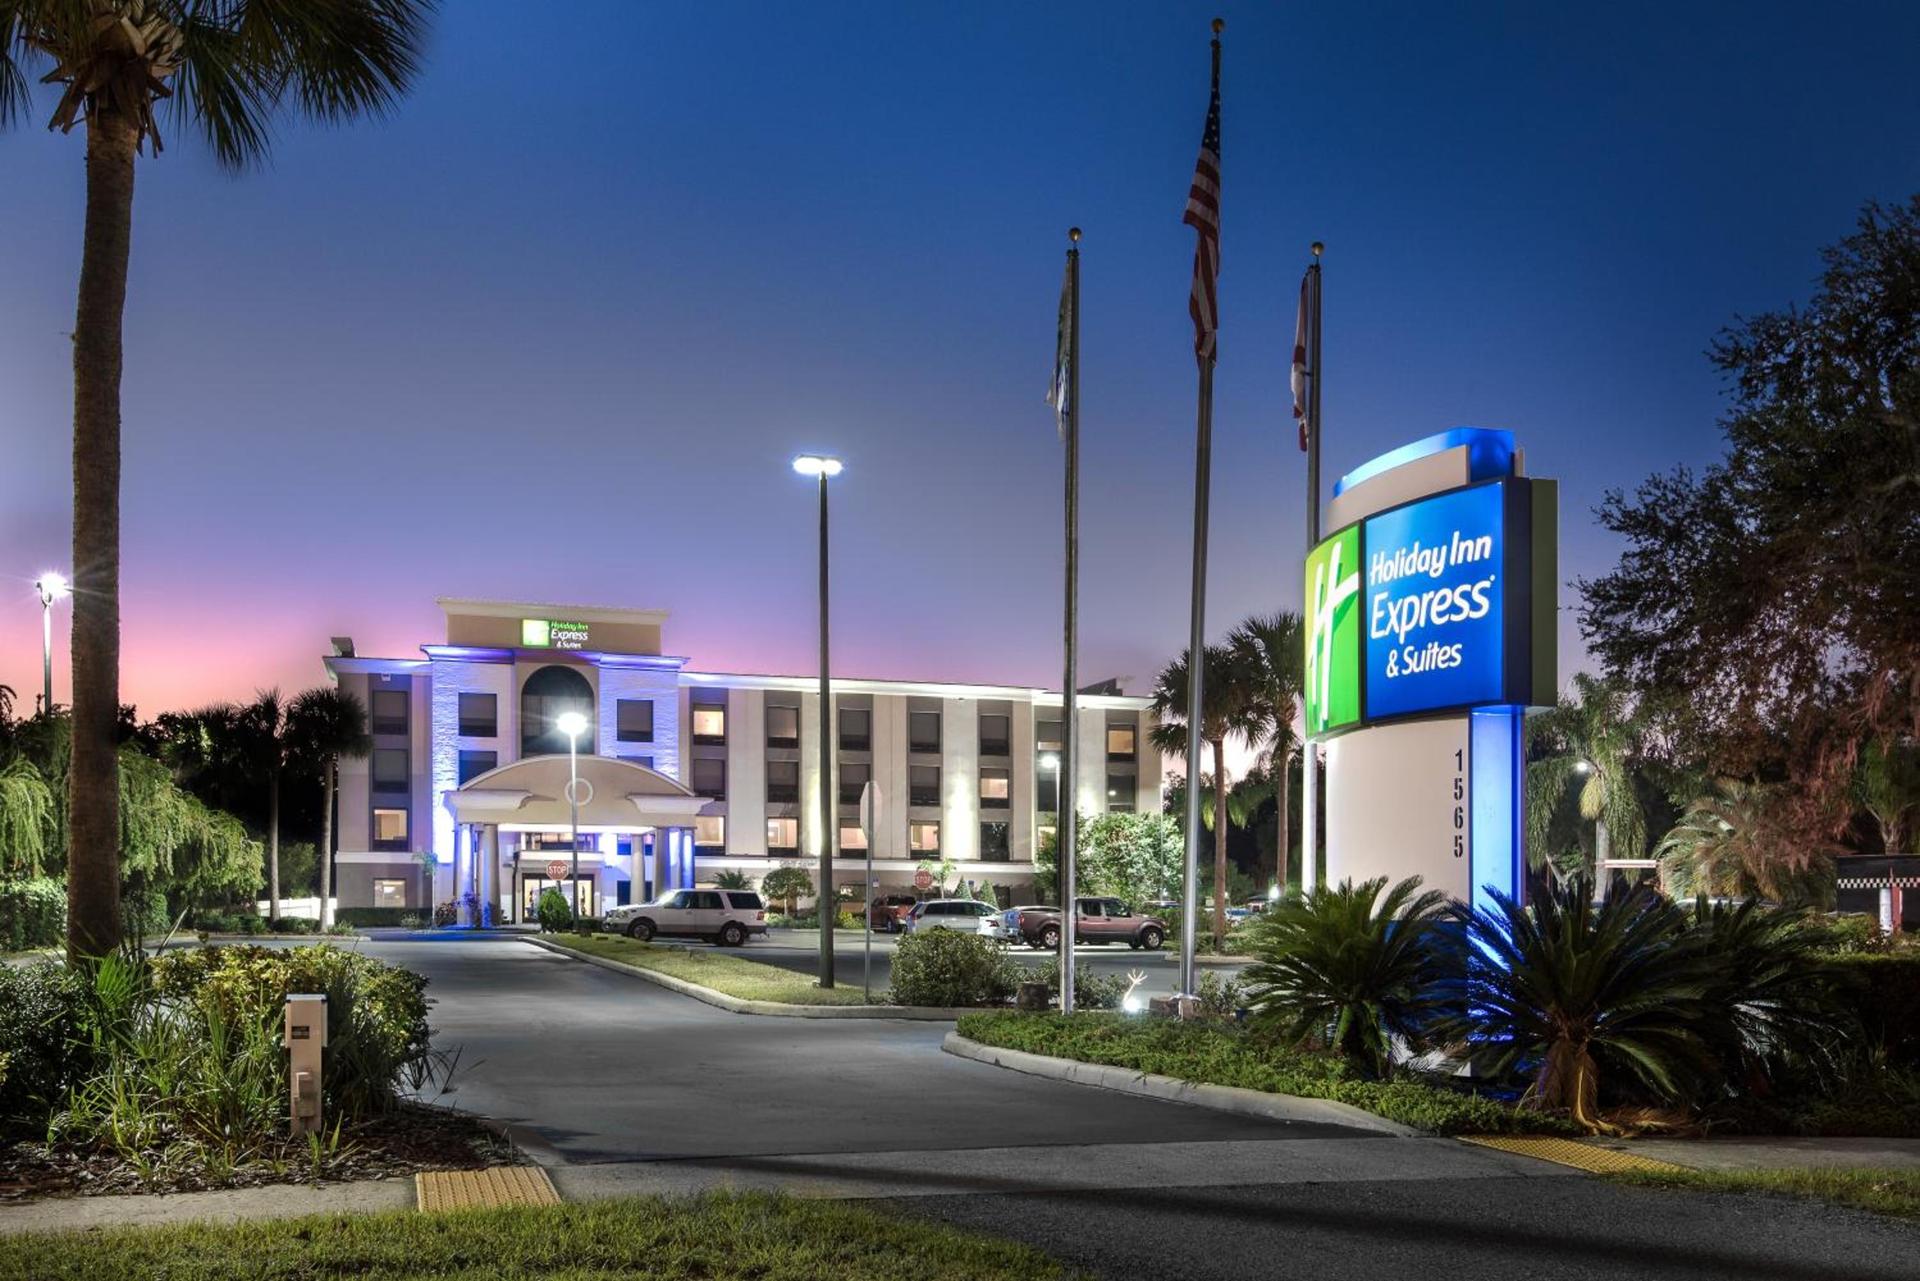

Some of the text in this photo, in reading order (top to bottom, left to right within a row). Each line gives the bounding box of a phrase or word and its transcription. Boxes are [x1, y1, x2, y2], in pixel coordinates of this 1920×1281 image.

[1370, 530, 1493, 586] Holiday Inn
[1370, 579, 1493, 645] Express
[551, 629, 589, 641] Express
[1386, 641, 1463, 679] & Suites
[549, 865, 567, 874] STOP
